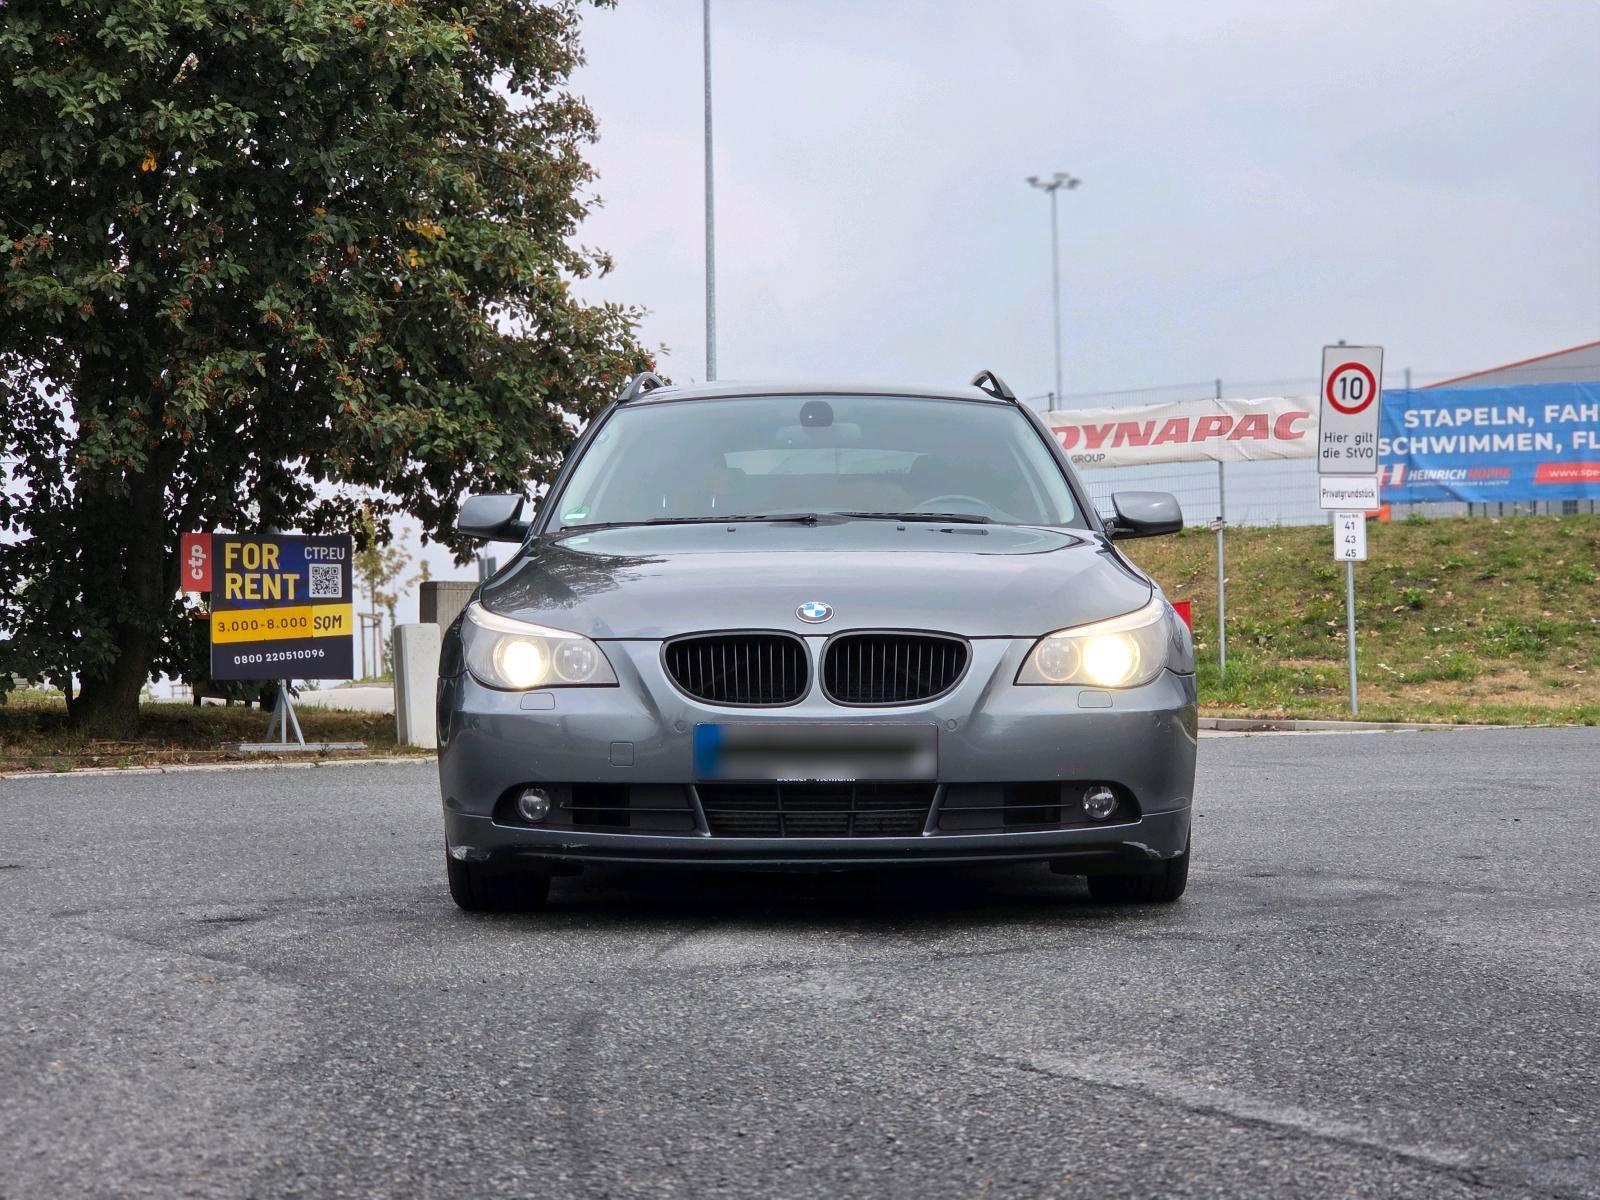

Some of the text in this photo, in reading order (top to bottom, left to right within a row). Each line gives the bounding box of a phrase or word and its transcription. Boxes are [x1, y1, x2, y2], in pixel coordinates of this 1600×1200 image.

[1339, 376, 1364, 401] 10
[1404, 404, 1599, 428] STAPELN, FAH
[1051, 411, 1311, 451] DYNAPAC
[1324, 432, 1374, 446] Hier gilt
[1378, 432, 1563, 456] SCHWIMMEN,
[1071, 453, 1106, 464] GROUP
[1322, 447, 1374, 459] die StVO
[1408, 469, 1467, 480] HEINRICH
[1322, 488, 1376, 501] Privatgrundstück
[1344, 521, 1356, 530] 41
[1344, 535, 1357, 544] 43
[224, 542, 280, 570] FOR
[304, 546, 345, 560] CTP.EU
[1345, 549, 1357, 558] 45
[187, 544, 208, 581] ctp
[225, 573, 300, 600] RENT
[217, 615, 343, 632] 3.000-8.000 SQM
[234, 649, 326, 665] 0800 220510096
